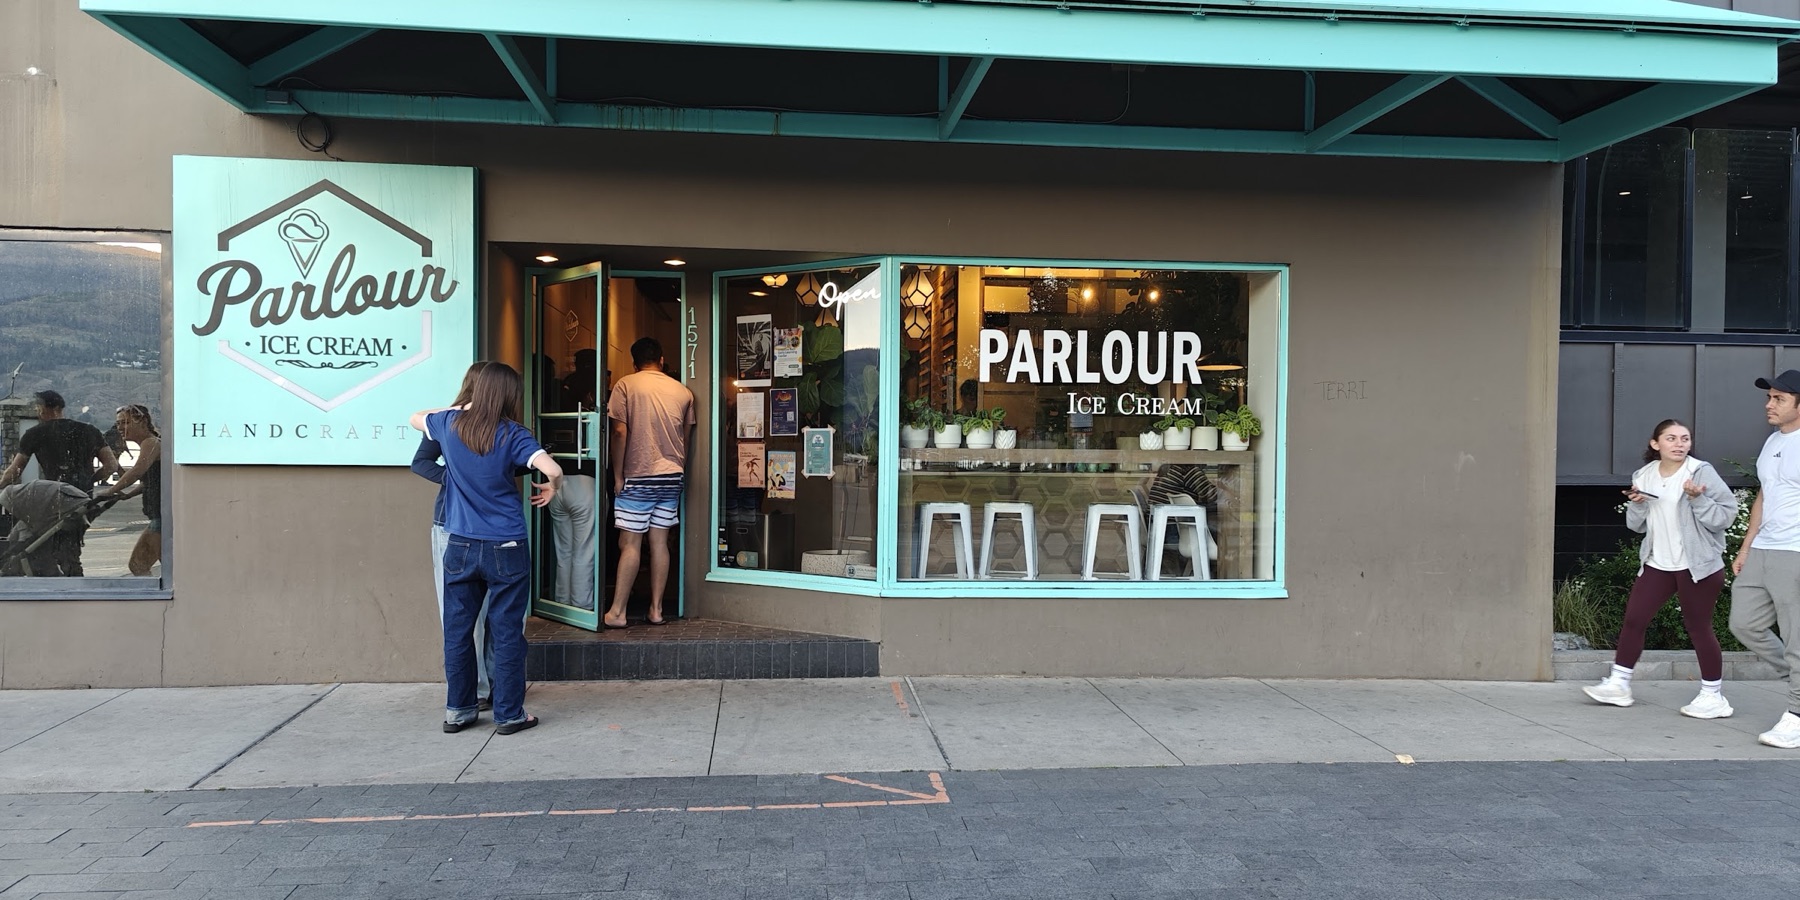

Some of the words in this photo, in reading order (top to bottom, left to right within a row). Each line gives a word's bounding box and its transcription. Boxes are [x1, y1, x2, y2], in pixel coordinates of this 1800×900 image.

[192, 244, 460, 336] Parlour
[818, 281, 881, 321] Open
[259, 335, 300, 354] ICE
[306, 336, 393, 356] CREAM
[687, 306, 698, 379] 1571
[979, 329, 1202, 385] PARLOUR
[1313, 380, 1368, 401] TERRI
[192, 423, 423, 440] HANDCRAFT
